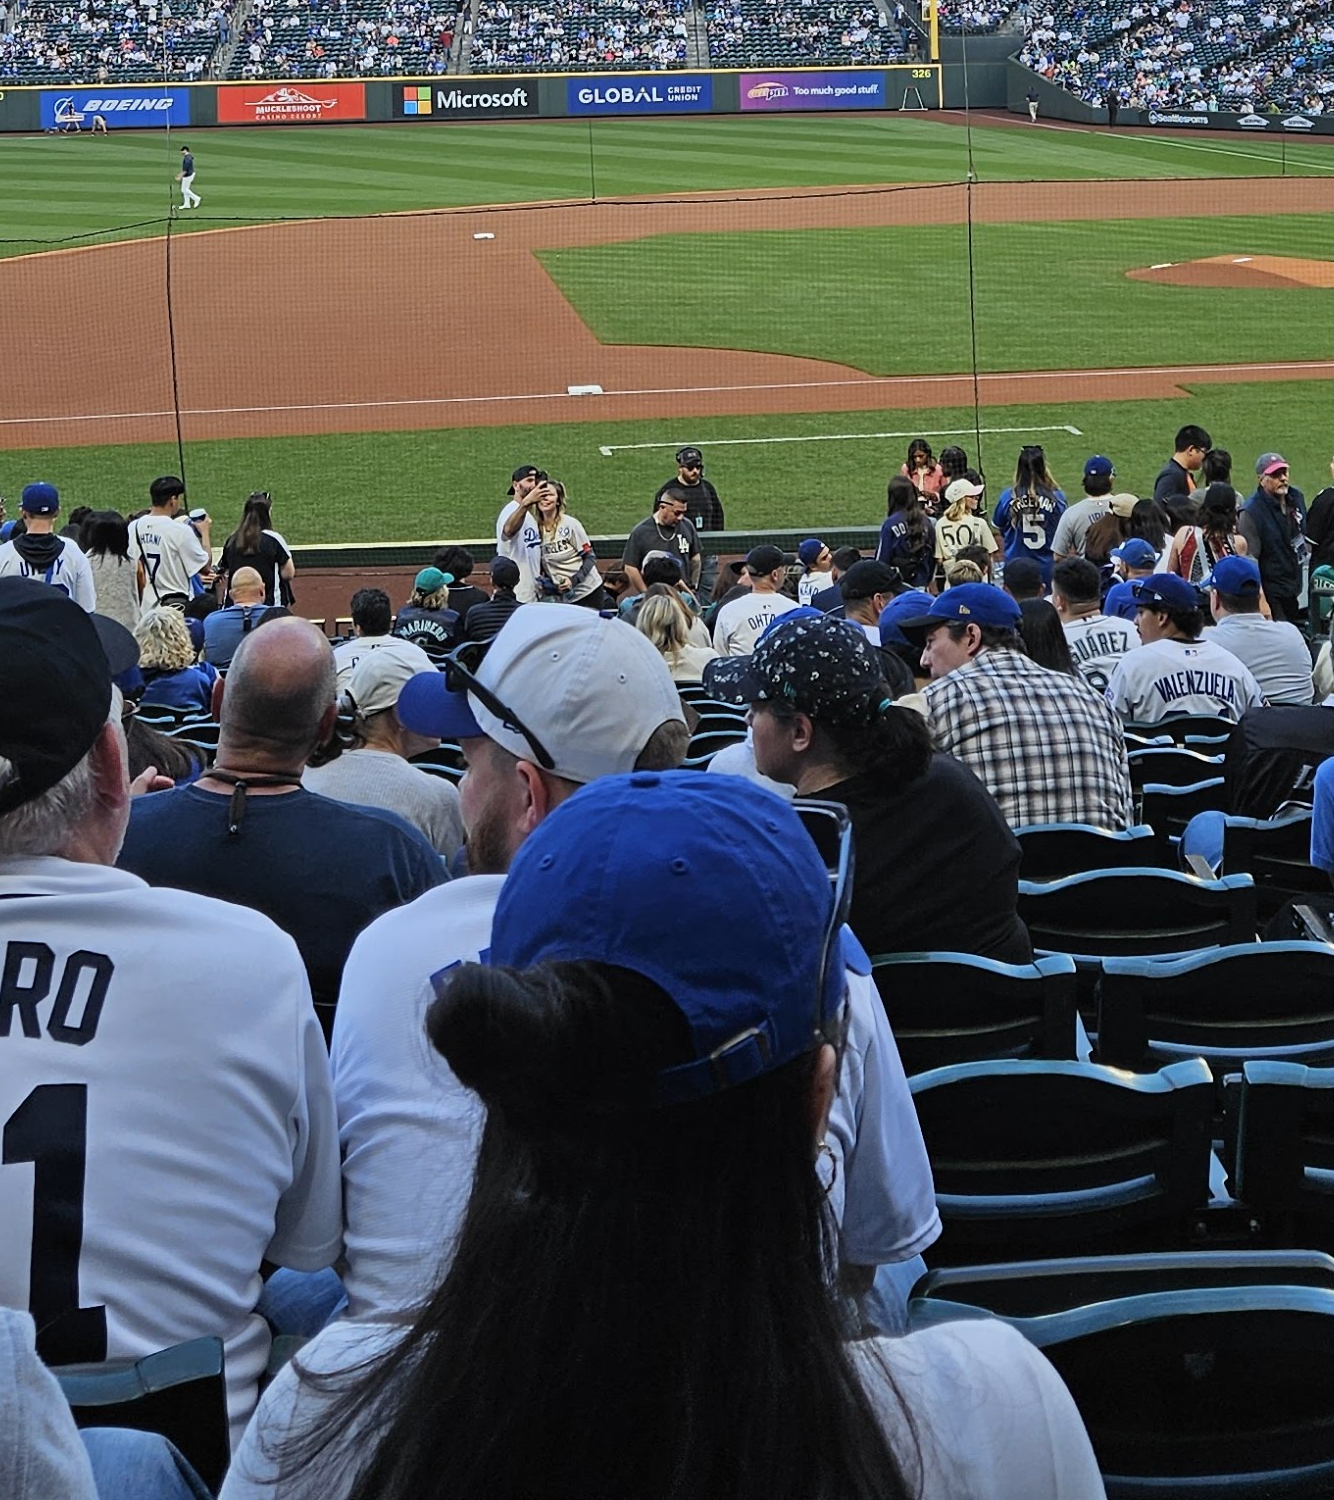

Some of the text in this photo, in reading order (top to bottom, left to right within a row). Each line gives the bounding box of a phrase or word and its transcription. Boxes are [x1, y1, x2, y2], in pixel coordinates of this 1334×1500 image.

[912, 69, 932, 79] 326
[436, 87, 528, 110] Microsoft
[578, 86, 702, 104] GLOBAL CREDIT
[668, 93, 699, 102] UNION
[793, 86, 809, 95] Too
[810, 85, 834, 95] much
[835, 85, 857, 97] good
[82, 98, 174, 112] BOEING
[255, 105, 322, 114] MUCKLESHOOT
[1022, 513, 1047, 550] 5
[399, 619, 449, 642] MARINERS
[1153, 669, 1236, 705] VALENZUELA
